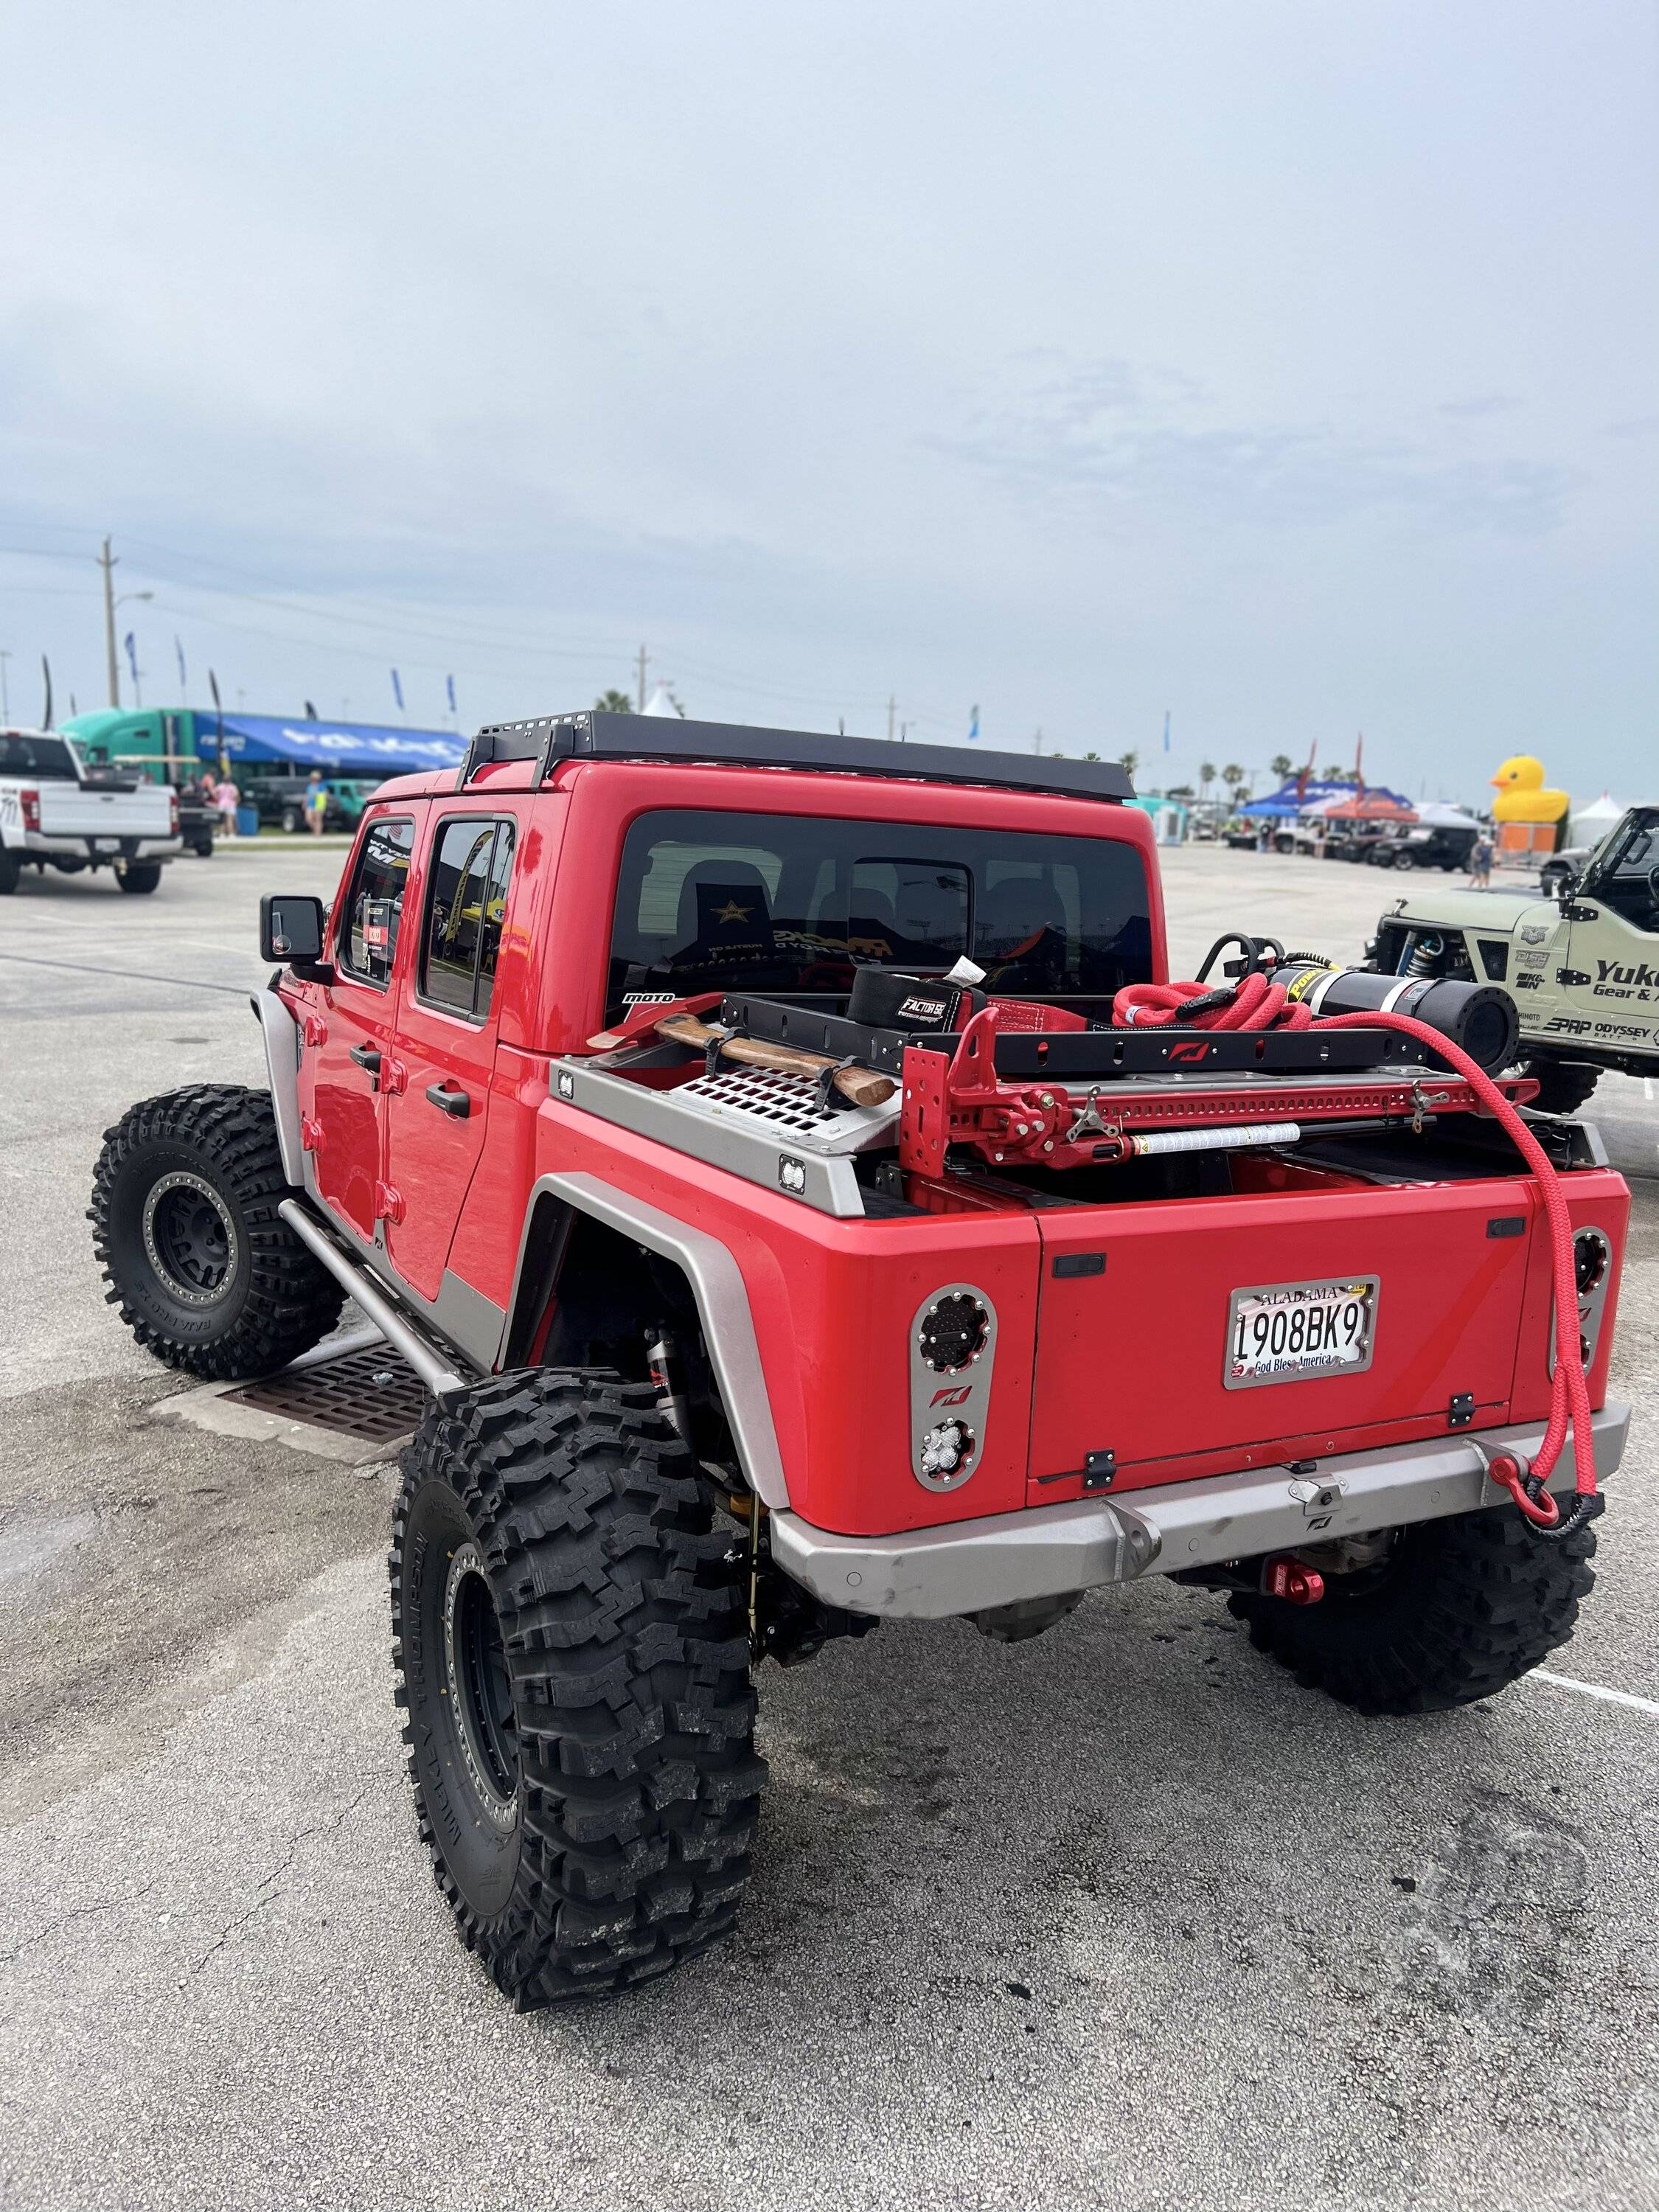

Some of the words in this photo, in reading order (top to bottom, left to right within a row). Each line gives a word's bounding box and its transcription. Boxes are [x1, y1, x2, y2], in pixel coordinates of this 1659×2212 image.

[1593, 984, 1635, 998] Gear
[1638, 989, 1650, 1001] &
[901, 998, 936, 1014] FACTOR
[1594, 1023, 1651, 1037] ODYSSEY
[1238, 1302, 1359, 1360] 1908BK9
[1255, 1360, 1272, 1373] God
[1274, 1358, 1295, 1371] Bles
[1299, 1352, 1331, 1367] America
